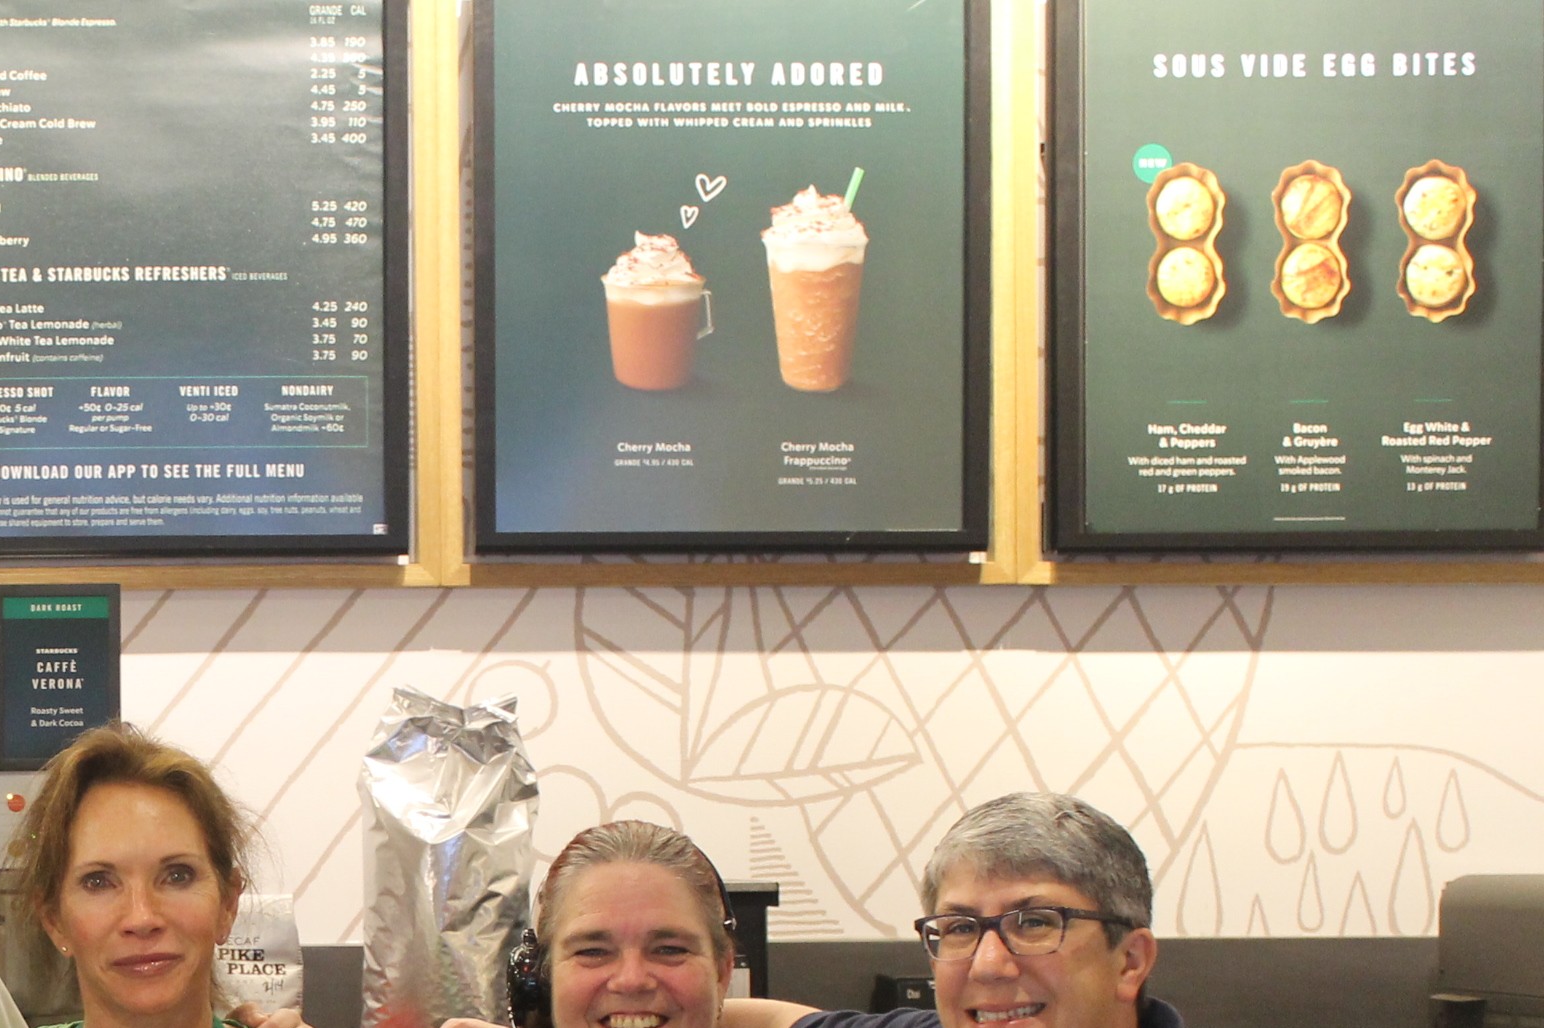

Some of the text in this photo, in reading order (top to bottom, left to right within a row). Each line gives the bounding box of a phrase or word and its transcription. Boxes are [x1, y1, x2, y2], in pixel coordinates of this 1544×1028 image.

[1153, 51, 1476, 78] SOUS VIDE EGG BITES
[574, 62, 883, 86] ABSOLUTELY ADORED
[586, 117, 872, 128] TOPPED WITH WHIPPED CREAM AND SPRINKLES
[310, 132, 336, 144] 3.45
[341, 132, 367, 144] 400
[311, 216, 336, 228] 4.75
[345, 216, 368, 228] 470
[0, 267, 28, 283] TEA
[32, 267, 43, 283] &
[47, 266, 130, 282] STARBUCKS
[134, 265, 229, 282] REFRESHERS
[26, 386, 54, 398] SHOT
[90, 386, 130, 398] FLAVOR
[1403, 421, 1470, 435] Egg White &
[616, 442, 691, 454] Cherry Mocha
[74, 464, 103, 479] OUR
[107, 464, 136, 479] APP
[140, 464, 159, 479] TO
[163, 464, 190, 479] SEE
[194, 463, 221, 479] THE
[226, 463, 261, 478] FULL
[265, 463, 305, 478] MENU
[30, 603, 82, 612] DARK ROAST
[36, 659, 77, 673] CAFFÈ
[31, 678, 83, 690] VERONA
[30, 706, 84, 716] Roasty Sweet
[30, 719, 84, 727] & Dark Cocoa
[226, 937, 260, 946] ECAF
[217, 949, 264, 961] PIKE
[227, 963, 286, 975] PLACE
